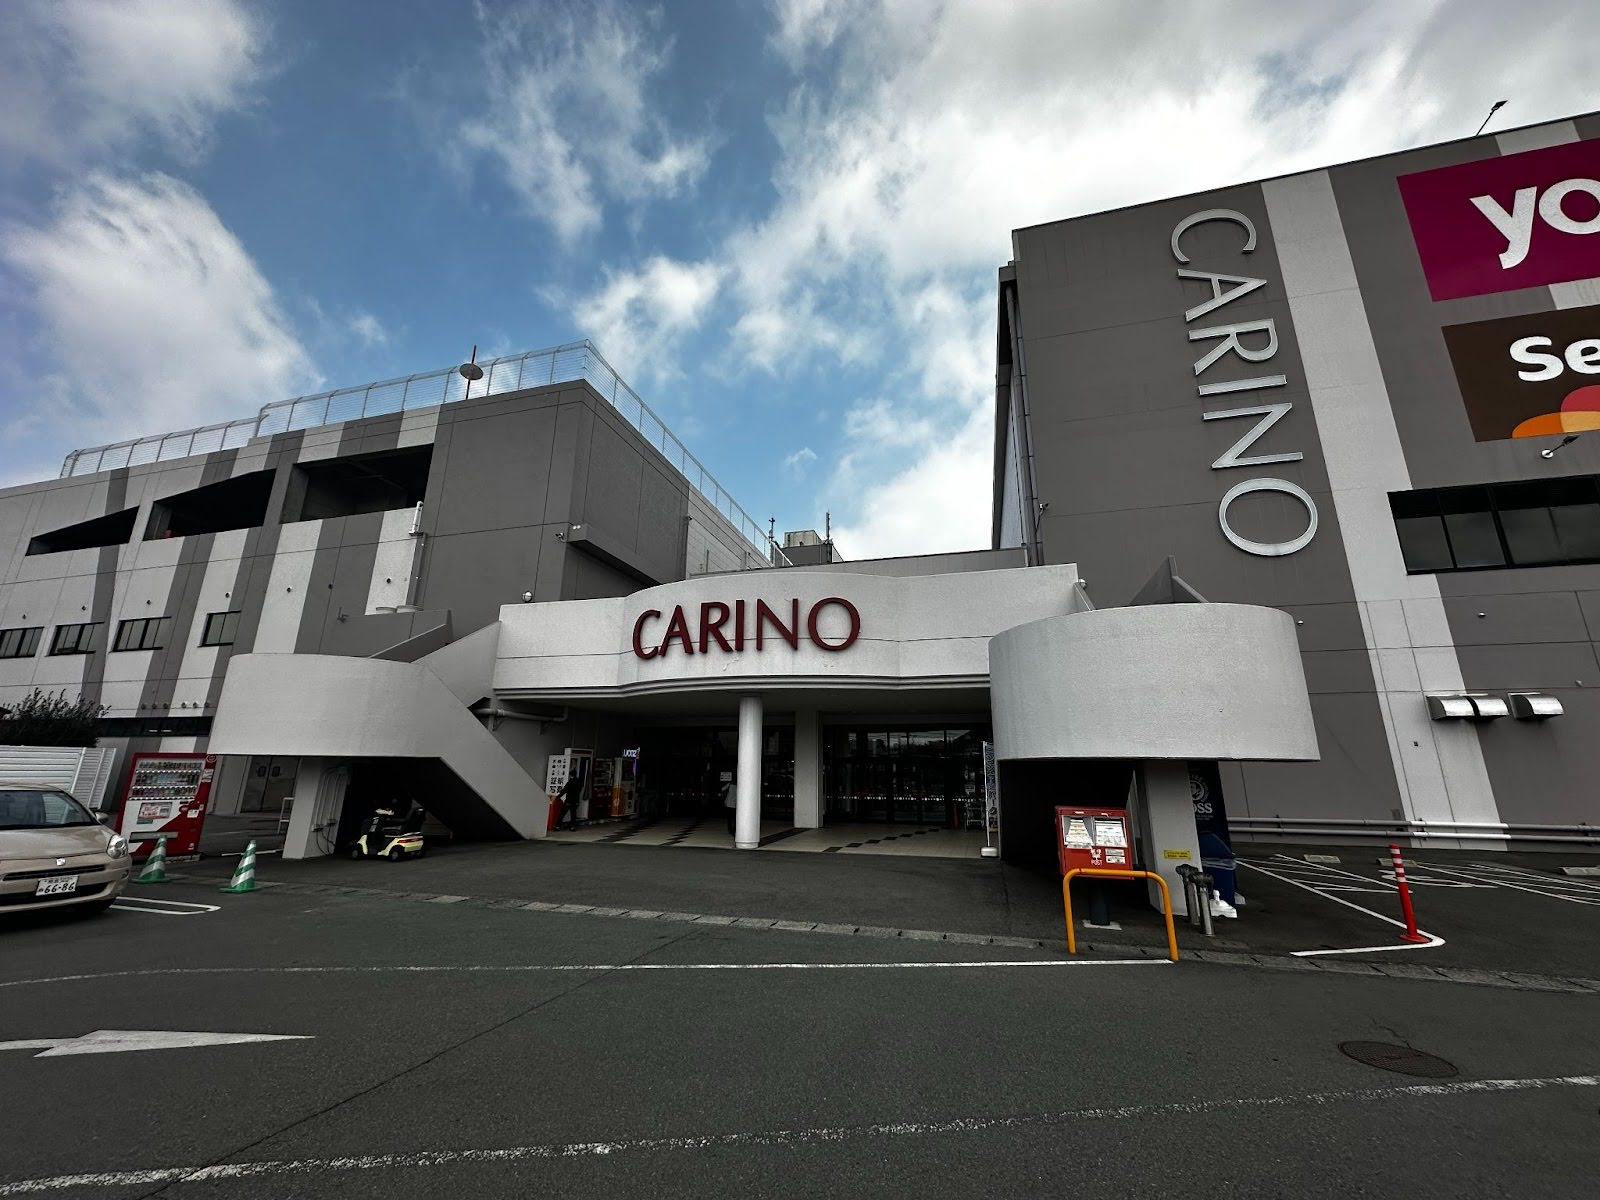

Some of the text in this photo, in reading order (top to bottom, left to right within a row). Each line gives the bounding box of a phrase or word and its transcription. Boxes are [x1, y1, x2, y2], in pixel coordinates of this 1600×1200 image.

[1171, 208, 1318, 556] CARINO
[632, 596, 861, 660] CARINO
[44, 882, 75, 894] 66-86
